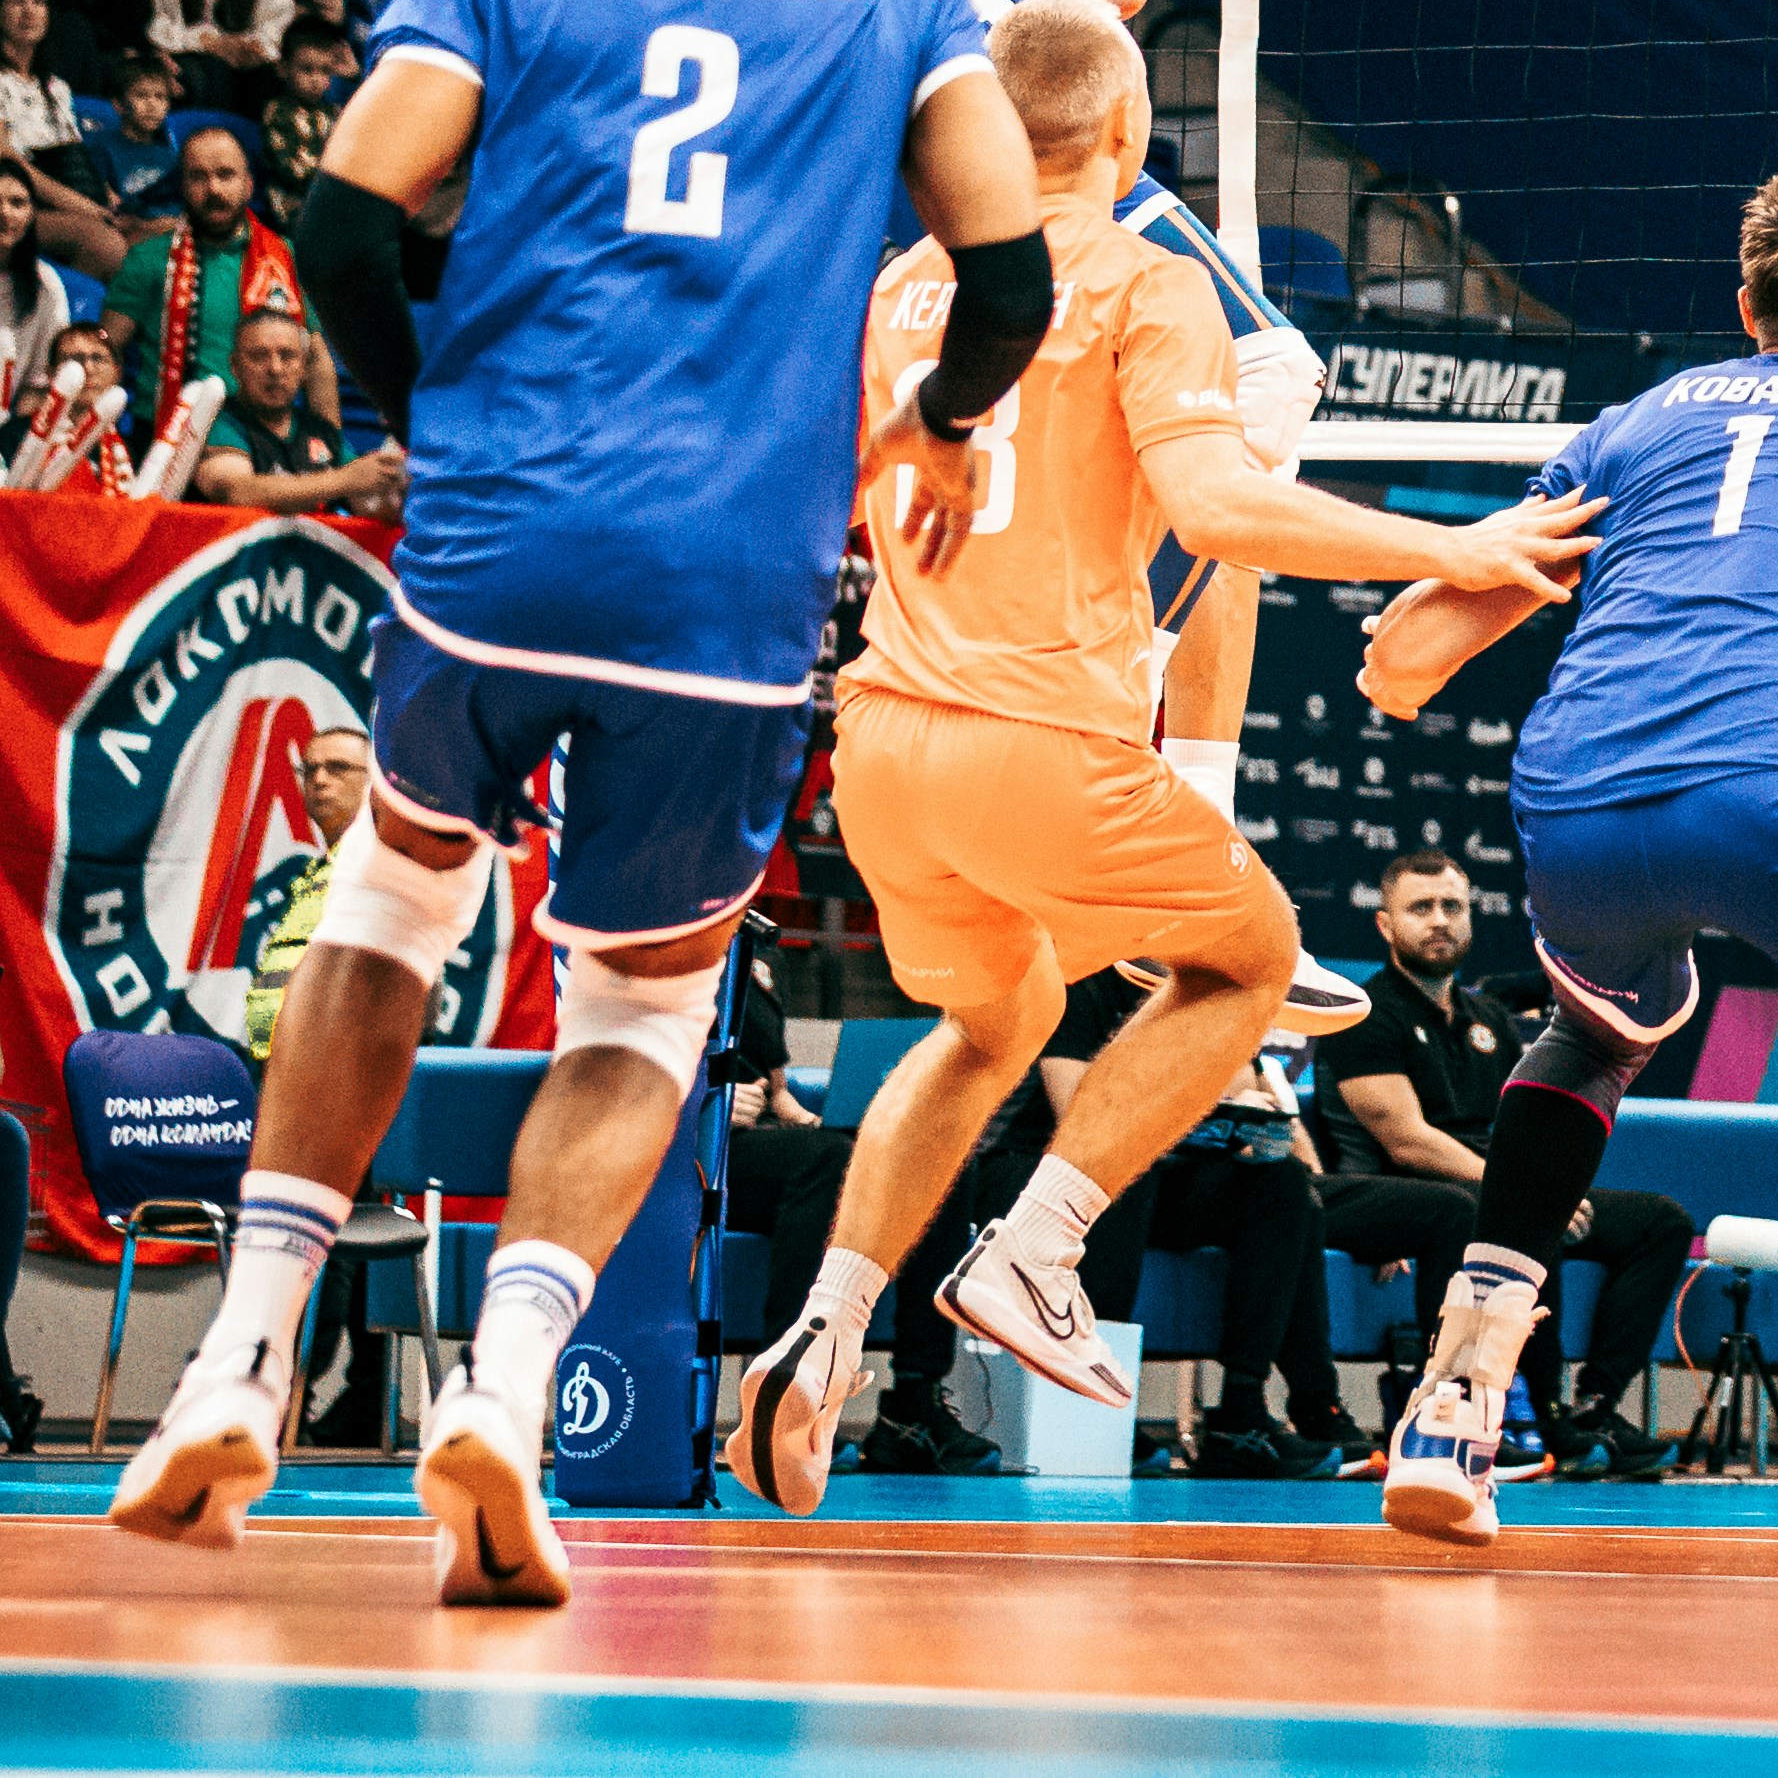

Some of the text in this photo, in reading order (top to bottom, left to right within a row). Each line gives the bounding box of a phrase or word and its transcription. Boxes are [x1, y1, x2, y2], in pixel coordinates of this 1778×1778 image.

[624, 24, 740, 238] 2
[1325, 343, 1567, 423] СУПЕРЛИГА
[1712, 414, 1776, 537] 1
[619, 1375, 636, 1430] ОБЛАСТЬ
